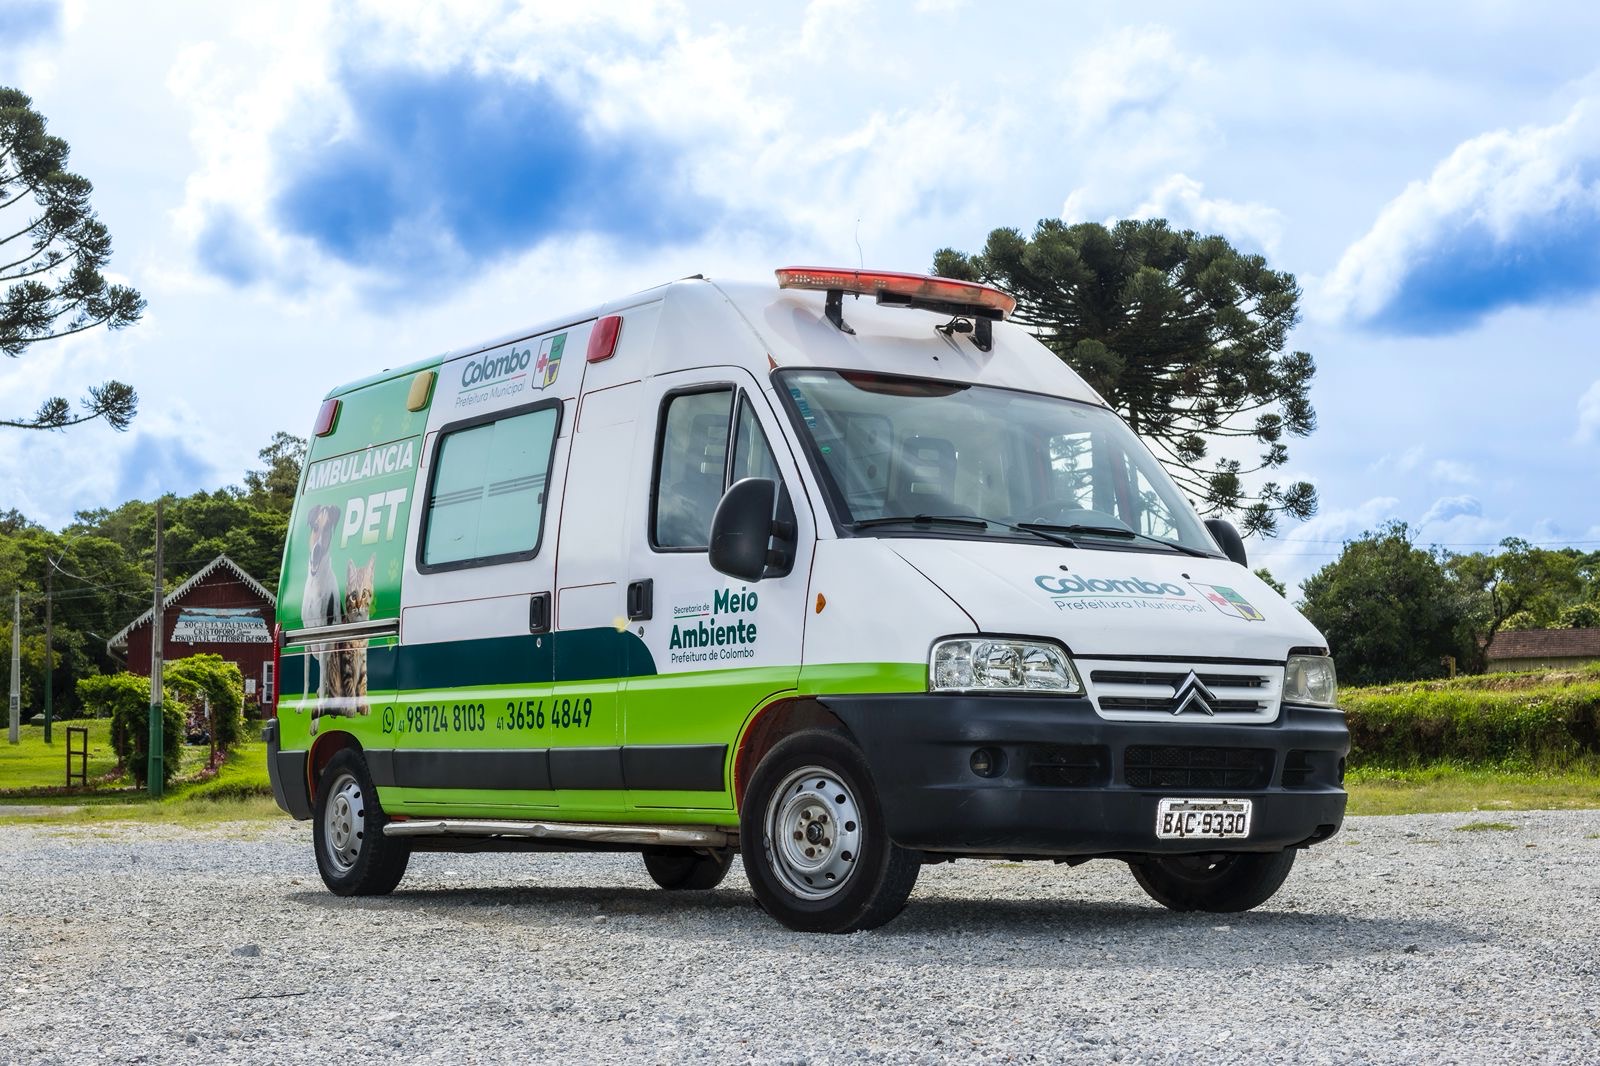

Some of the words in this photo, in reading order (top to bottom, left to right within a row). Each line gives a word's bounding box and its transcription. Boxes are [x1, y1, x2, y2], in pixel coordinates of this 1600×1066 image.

[462, 347, 531, 387] Colombo
[455, 392, 489, 408] Prefeitura
[489, 379, 526, 399] Municipal
[305, 442, 413, 490] AMBULÂNCIA
[340, 488, 408, 549] PET
[1034, 574, 1187, 597] Colombo
[673, 604, 702, 615] Secretaria
[702, 603, 710, 612] de
[713, 586, 759, 615] Meio
[1054, 600, 1132, 612] Prefeitura
[1134, 599, 1207, 613] Municipal
[669, 617, 757, 650] Ambiente
[671, 652, 707, 664] Prefeitura
[708, 650, 718, 661] de
[720, 647, 755, 660] Colombo
[398, 719, 405, 732] 41
[407, 705, 448, 732] 98724
[453, 703, 485, 731] 8103
[496, 716, 504, 730] 41
[506, 700, 545, 730] 3656
[551, 698, 593, 729] 4849
